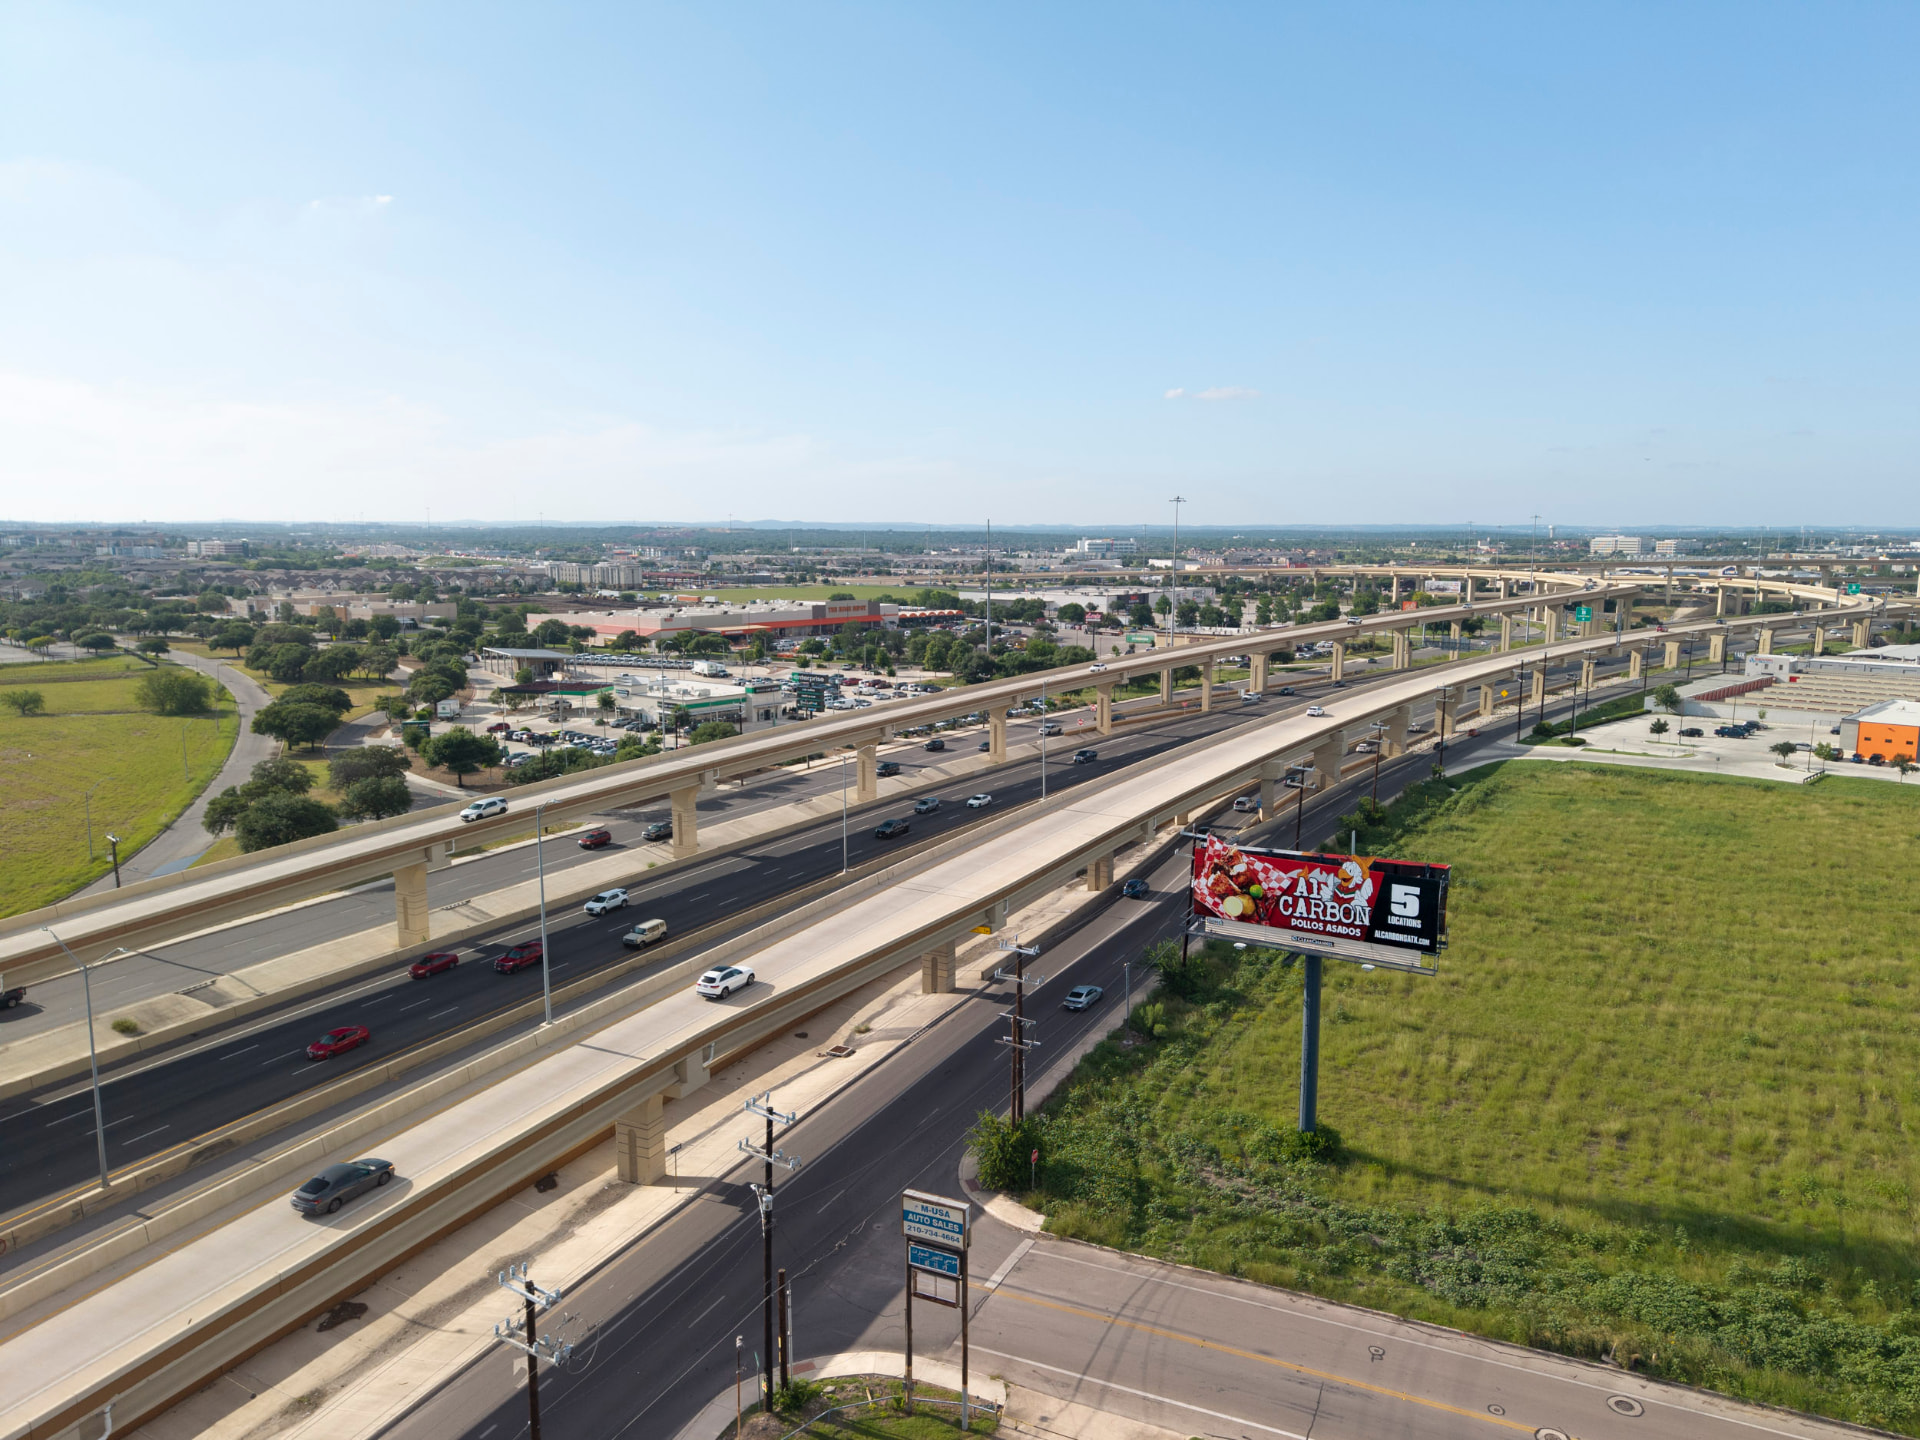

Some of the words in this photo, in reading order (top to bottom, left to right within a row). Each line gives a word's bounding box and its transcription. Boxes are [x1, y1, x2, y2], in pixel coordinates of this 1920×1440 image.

[1390, 883, 1421, 917] 5
[1279, 895, 1372, 926] CARBON
[1291, 918, 1324, 930] POLLOS
[1326, 924, 1361, 937] ASADOS
[1387, 915, 1422, 928] LOCATIONS
[921, 1204, 950, 1218] M-USA
[907, 1213, 931, 1225] AUTO
[932, 1219, 959, 1232] SALES
[907, 1224, 960, 1243] 210-734-4664
